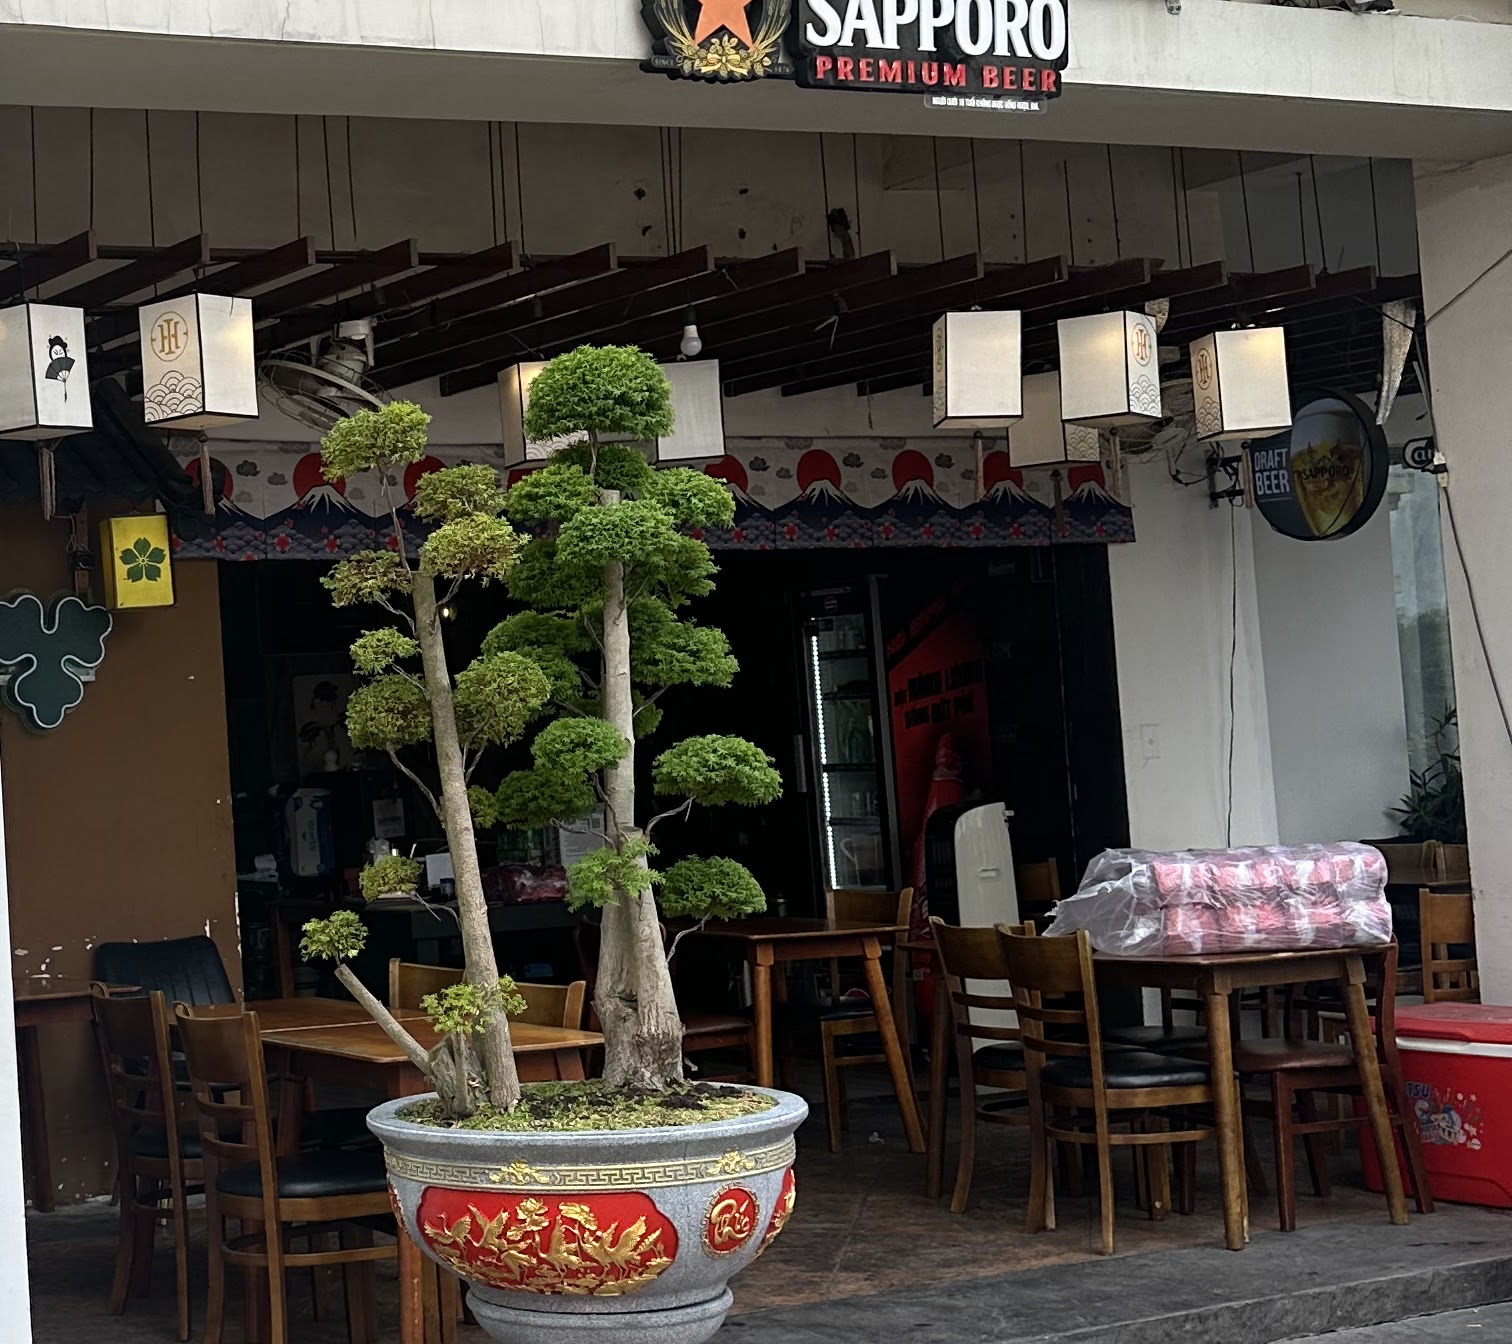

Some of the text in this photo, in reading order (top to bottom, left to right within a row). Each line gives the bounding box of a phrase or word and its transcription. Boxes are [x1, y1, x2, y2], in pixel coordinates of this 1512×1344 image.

[814, 54, 1058, 93] PREMIUM BEER
[1254, 447, 1289, 472] DRAFT
[1255, 470, 1291, 496] BEER
[1302, 465, 1351, 481] SAPPORO
[1406, 1082, 1431, 1099] TSU
